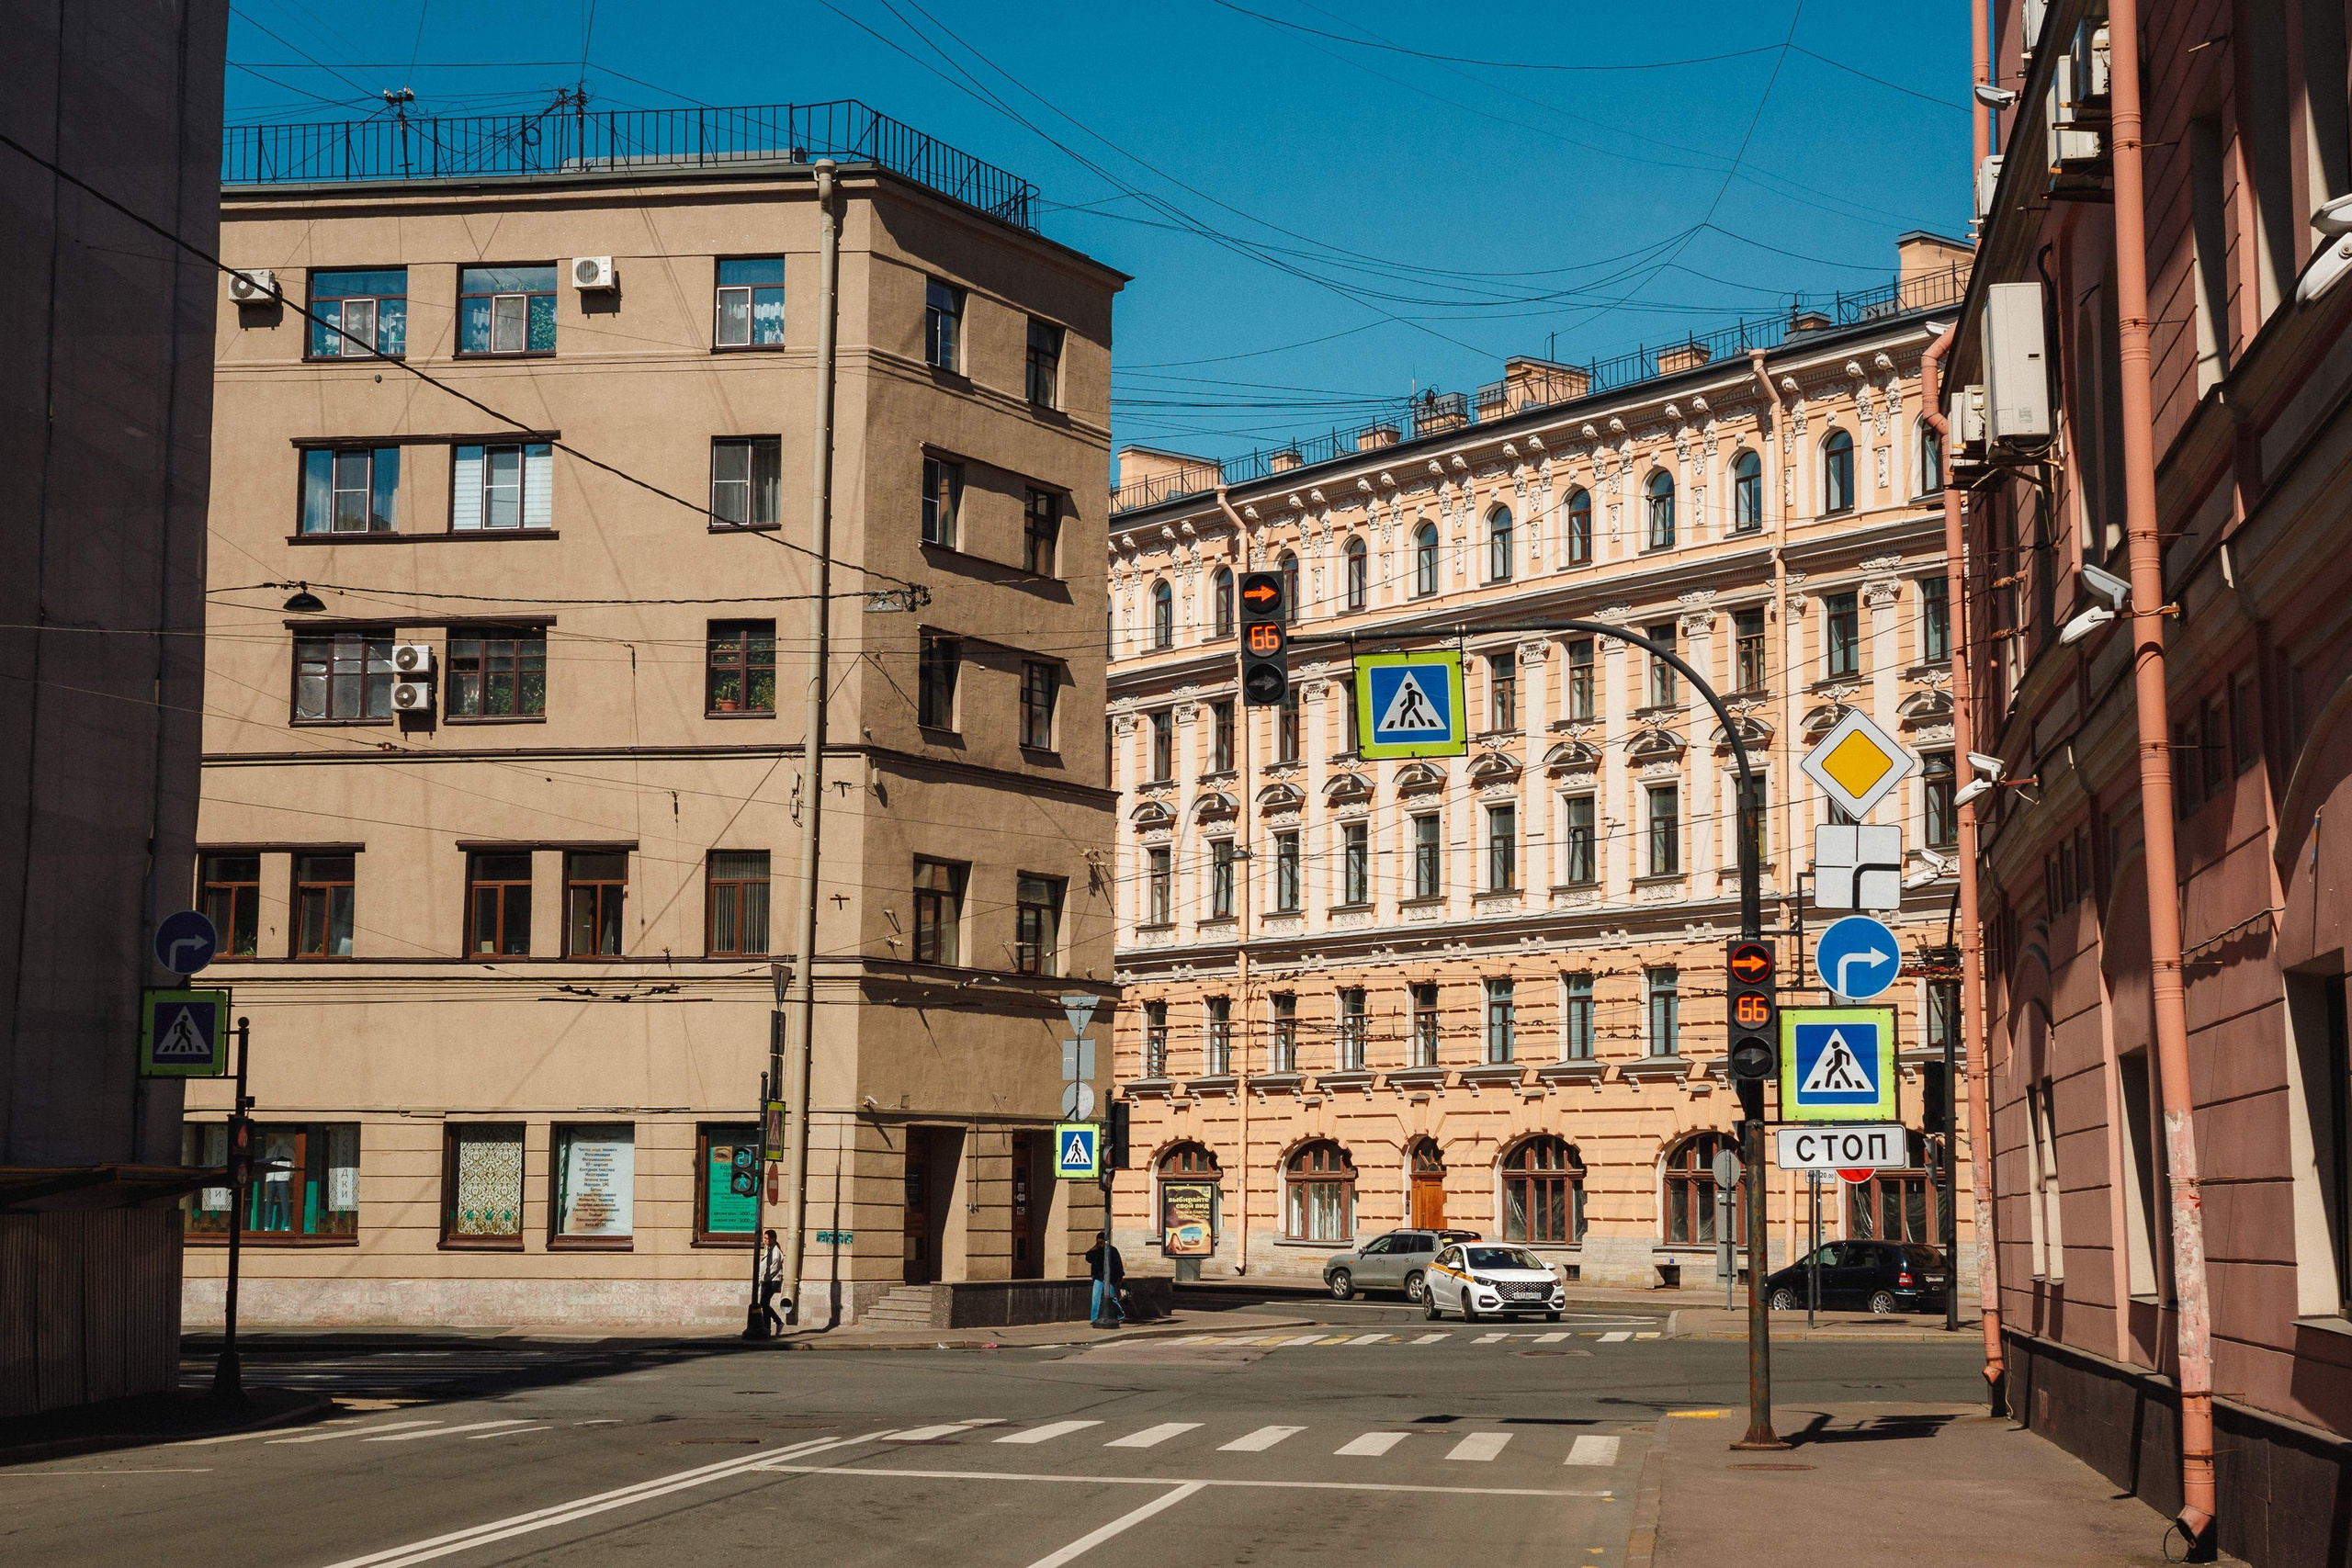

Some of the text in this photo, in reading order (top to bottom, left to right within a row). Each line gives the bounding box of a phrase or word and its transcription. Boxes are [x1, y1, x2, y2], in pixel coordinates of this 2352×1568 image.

[1251, 626, 1280, 650] 66
[1737, 997, 1769, 1022] 66
[736, 1151, 752, 1166] 21
[1796, 1134, 1888, 1162] СТОП
